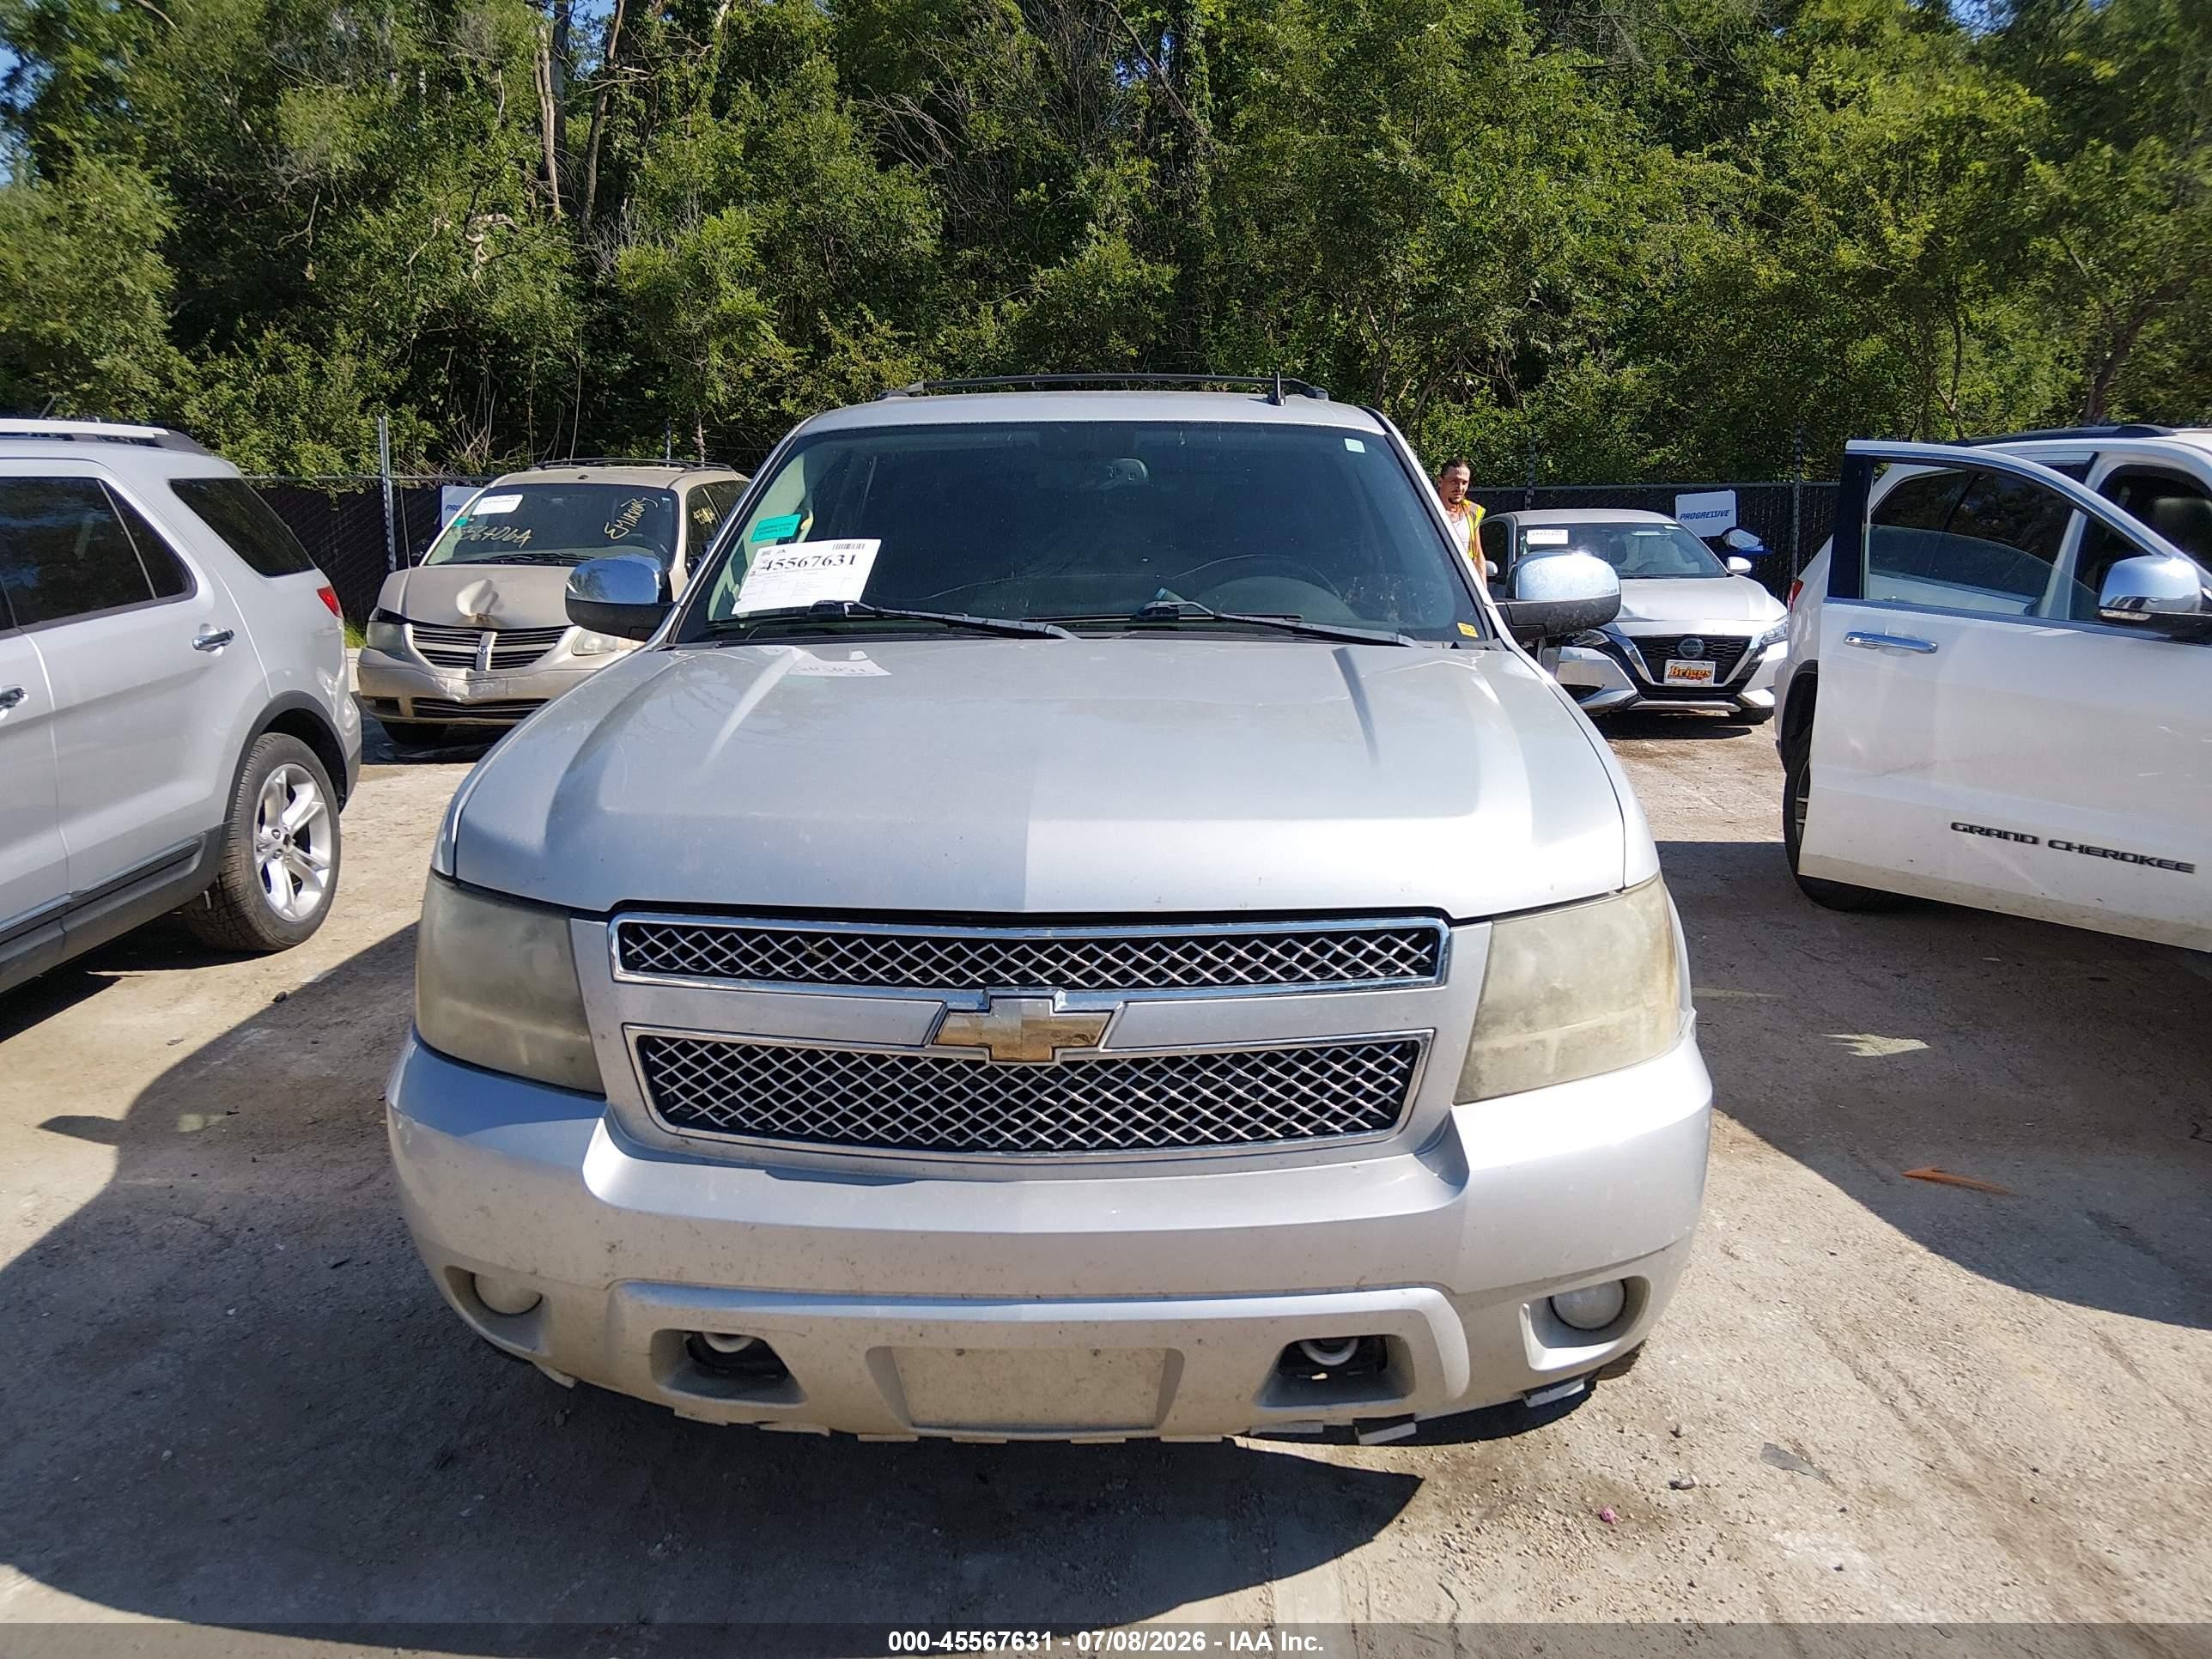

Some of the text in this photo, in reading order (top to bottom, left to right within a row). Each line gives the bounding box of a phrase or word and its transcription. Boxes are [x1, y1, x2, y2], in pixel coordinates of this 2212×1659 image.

[1680, 509, 1730, 520] PROGRESSIVE
[760, 554, 856, 571] 45567631
[1669, 665, 1711, 680] Briggs
[1950, 822, 2196, 874] GRAND CHEROKEE
